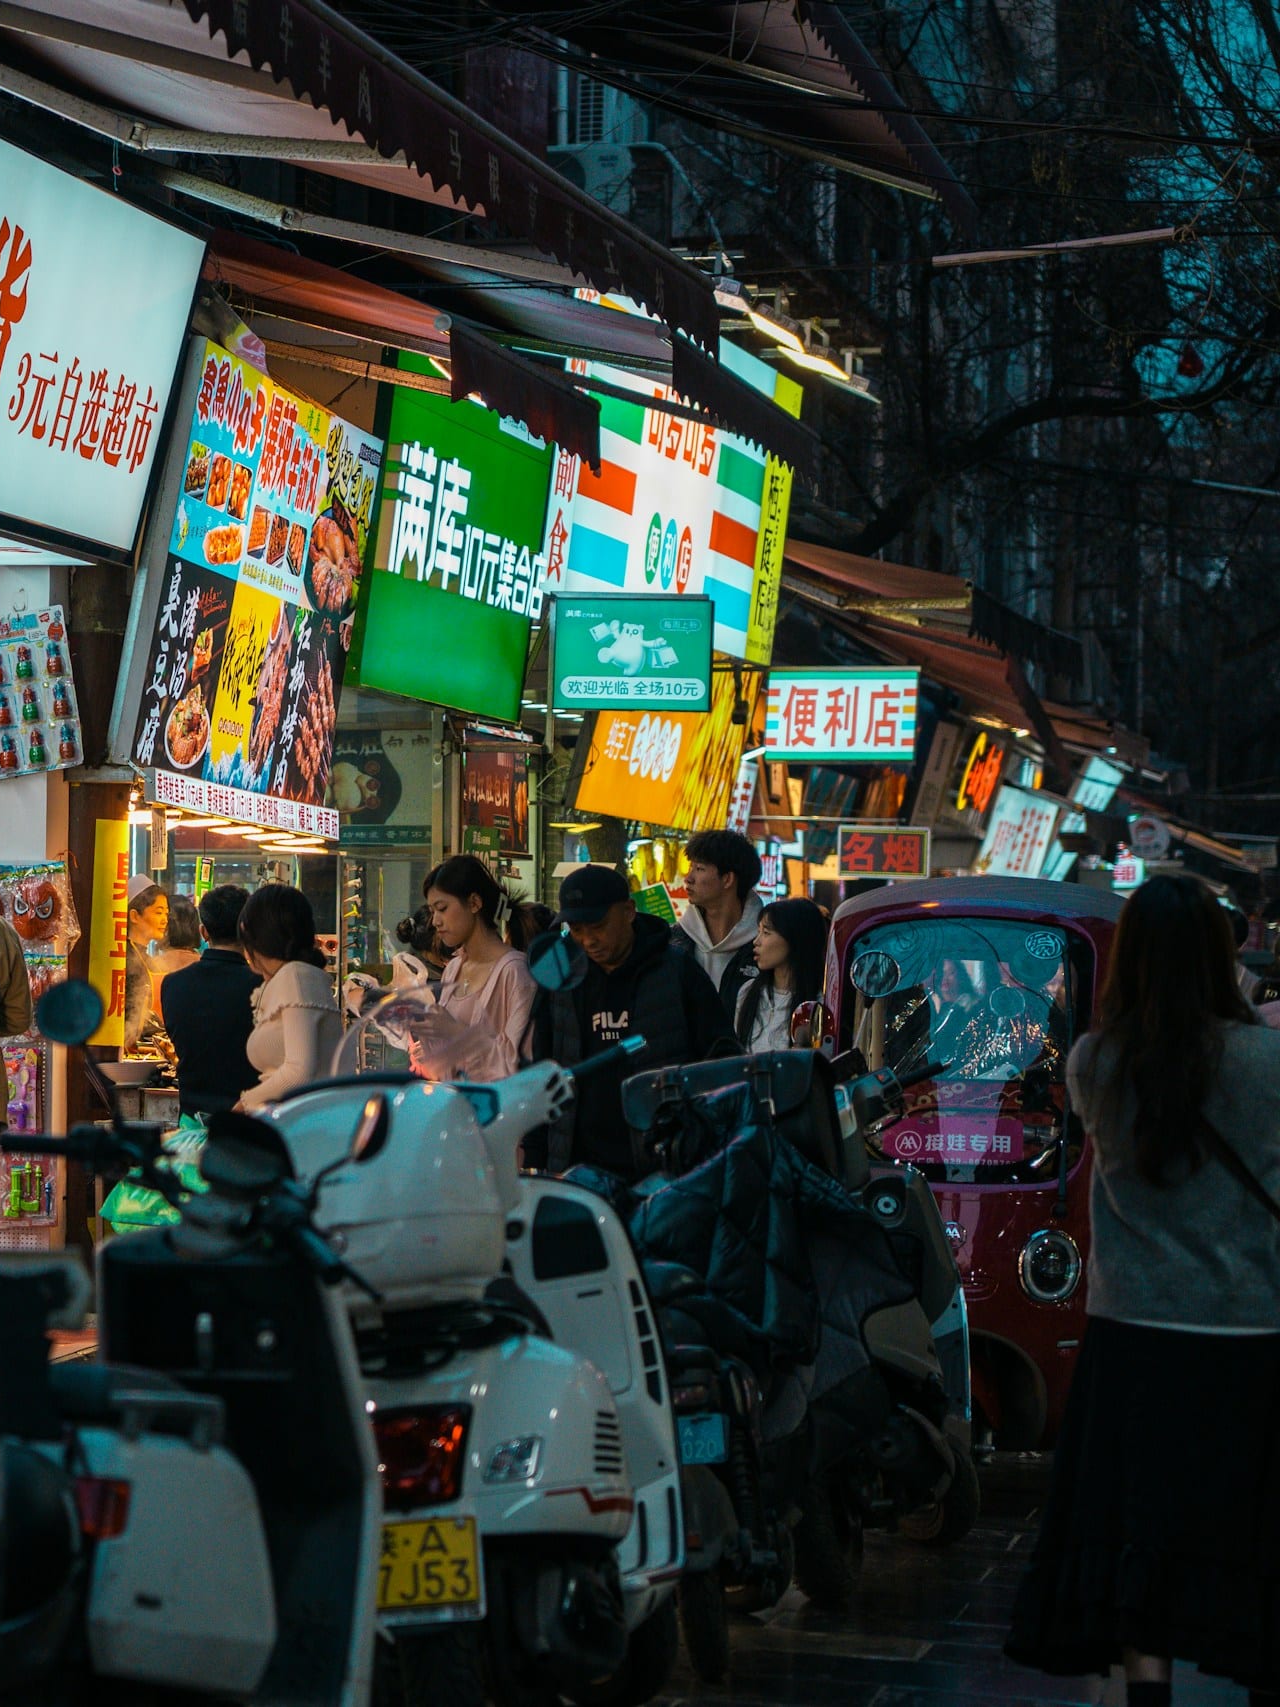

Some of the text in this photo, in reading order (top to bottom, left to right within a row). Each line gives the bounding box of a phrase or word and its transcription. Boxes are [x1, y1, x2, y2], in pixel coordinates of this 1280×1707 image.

[8, 351, 159, 474] 3元自选超市
[547, 448, 577, 584] 副食
[648, 525, 692, 588] 便利店
[136, 562, 182, 765] 臭豆腐
[168, 584, 200, 700] 灌汤
[272, 615, 312, 795] 红柳烤肉
[568, 680, 698, 697] 欢迎光临 全场10元
[782, 684, 901, 748] 便利店
[841, 832, 920, 872] 名烟
[592, 1009, 629, 1032] FILA
[924, 1133, 1012, 1153] 接娃专用
